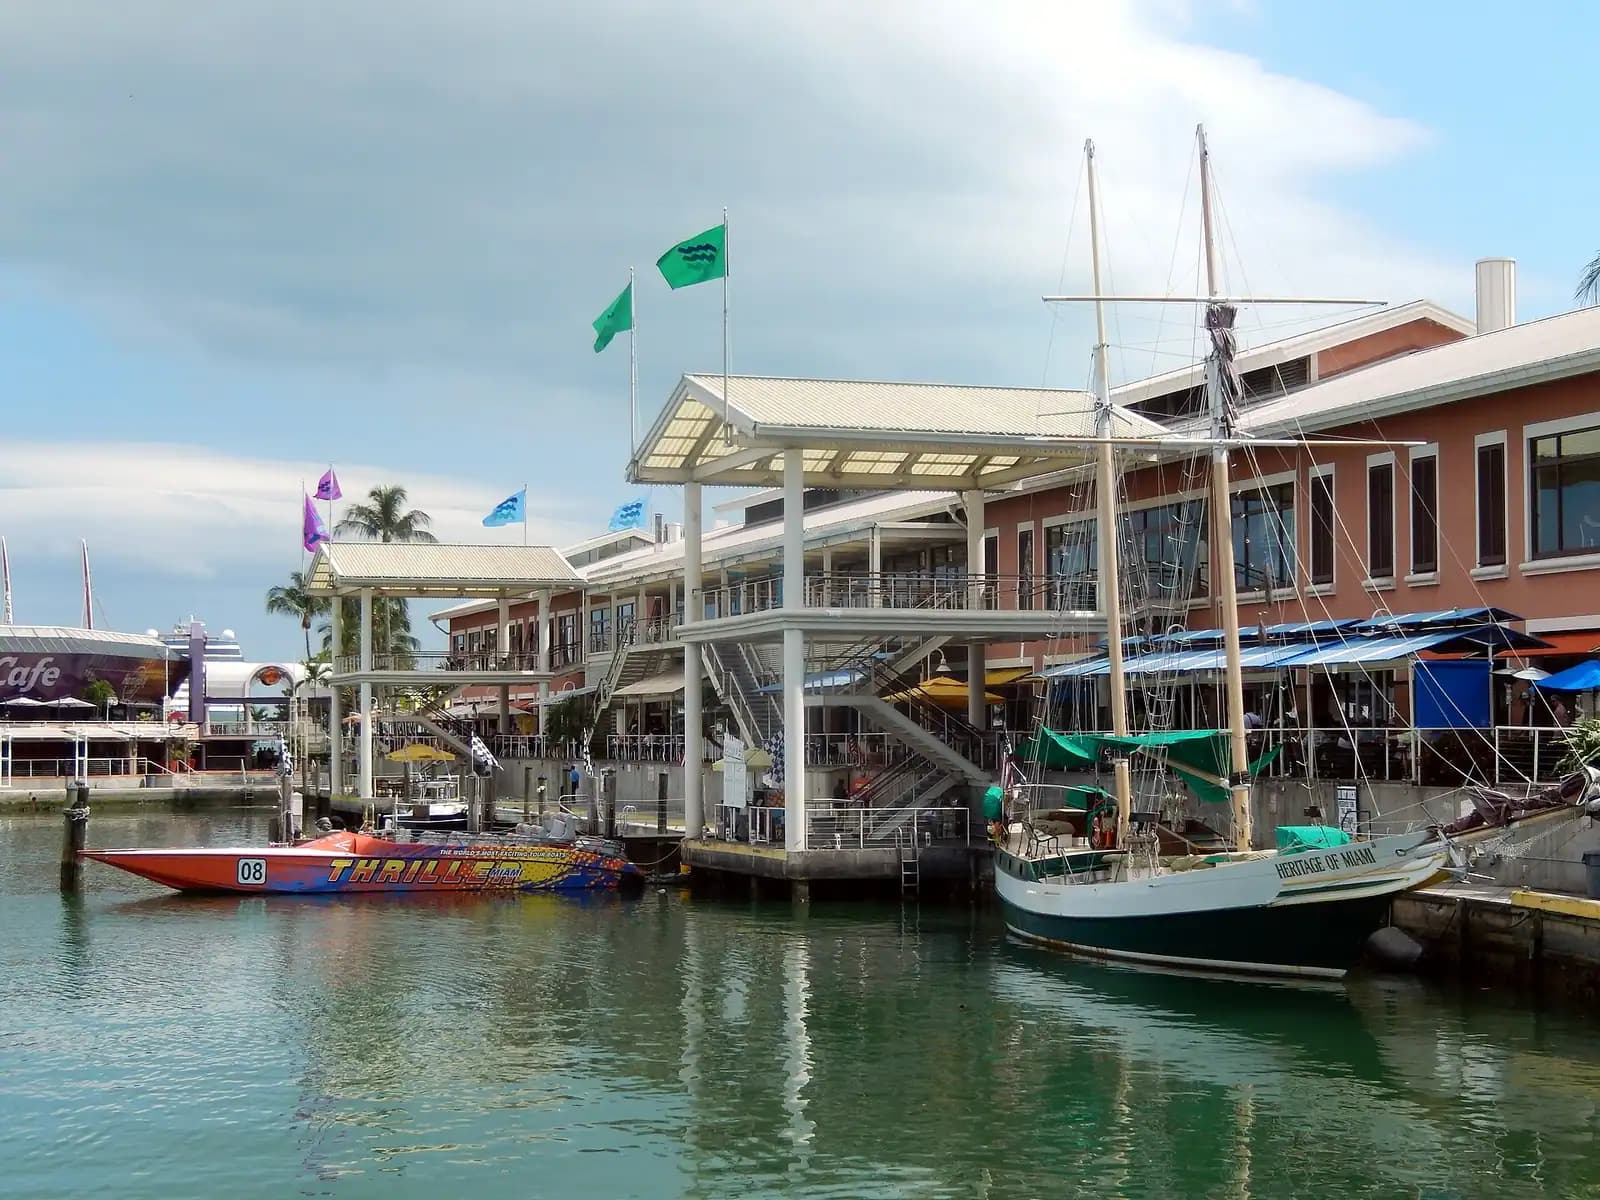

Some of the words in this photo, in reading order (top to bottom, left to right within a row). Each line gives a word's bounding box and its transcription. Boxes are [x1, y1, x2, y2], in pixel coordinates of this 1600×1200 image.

[4, 594, 12, 624] CARI
[241, 862, 263, 881] 08
[327, 859, 522, 884] THRILLER
[488, 868, 522, 878] MIAMI
[1275, 857, 1325, 879] HERITAGE
[1327, 853, 1340, 871] OF
[1342, 848, 1376, 868] MIAMI
